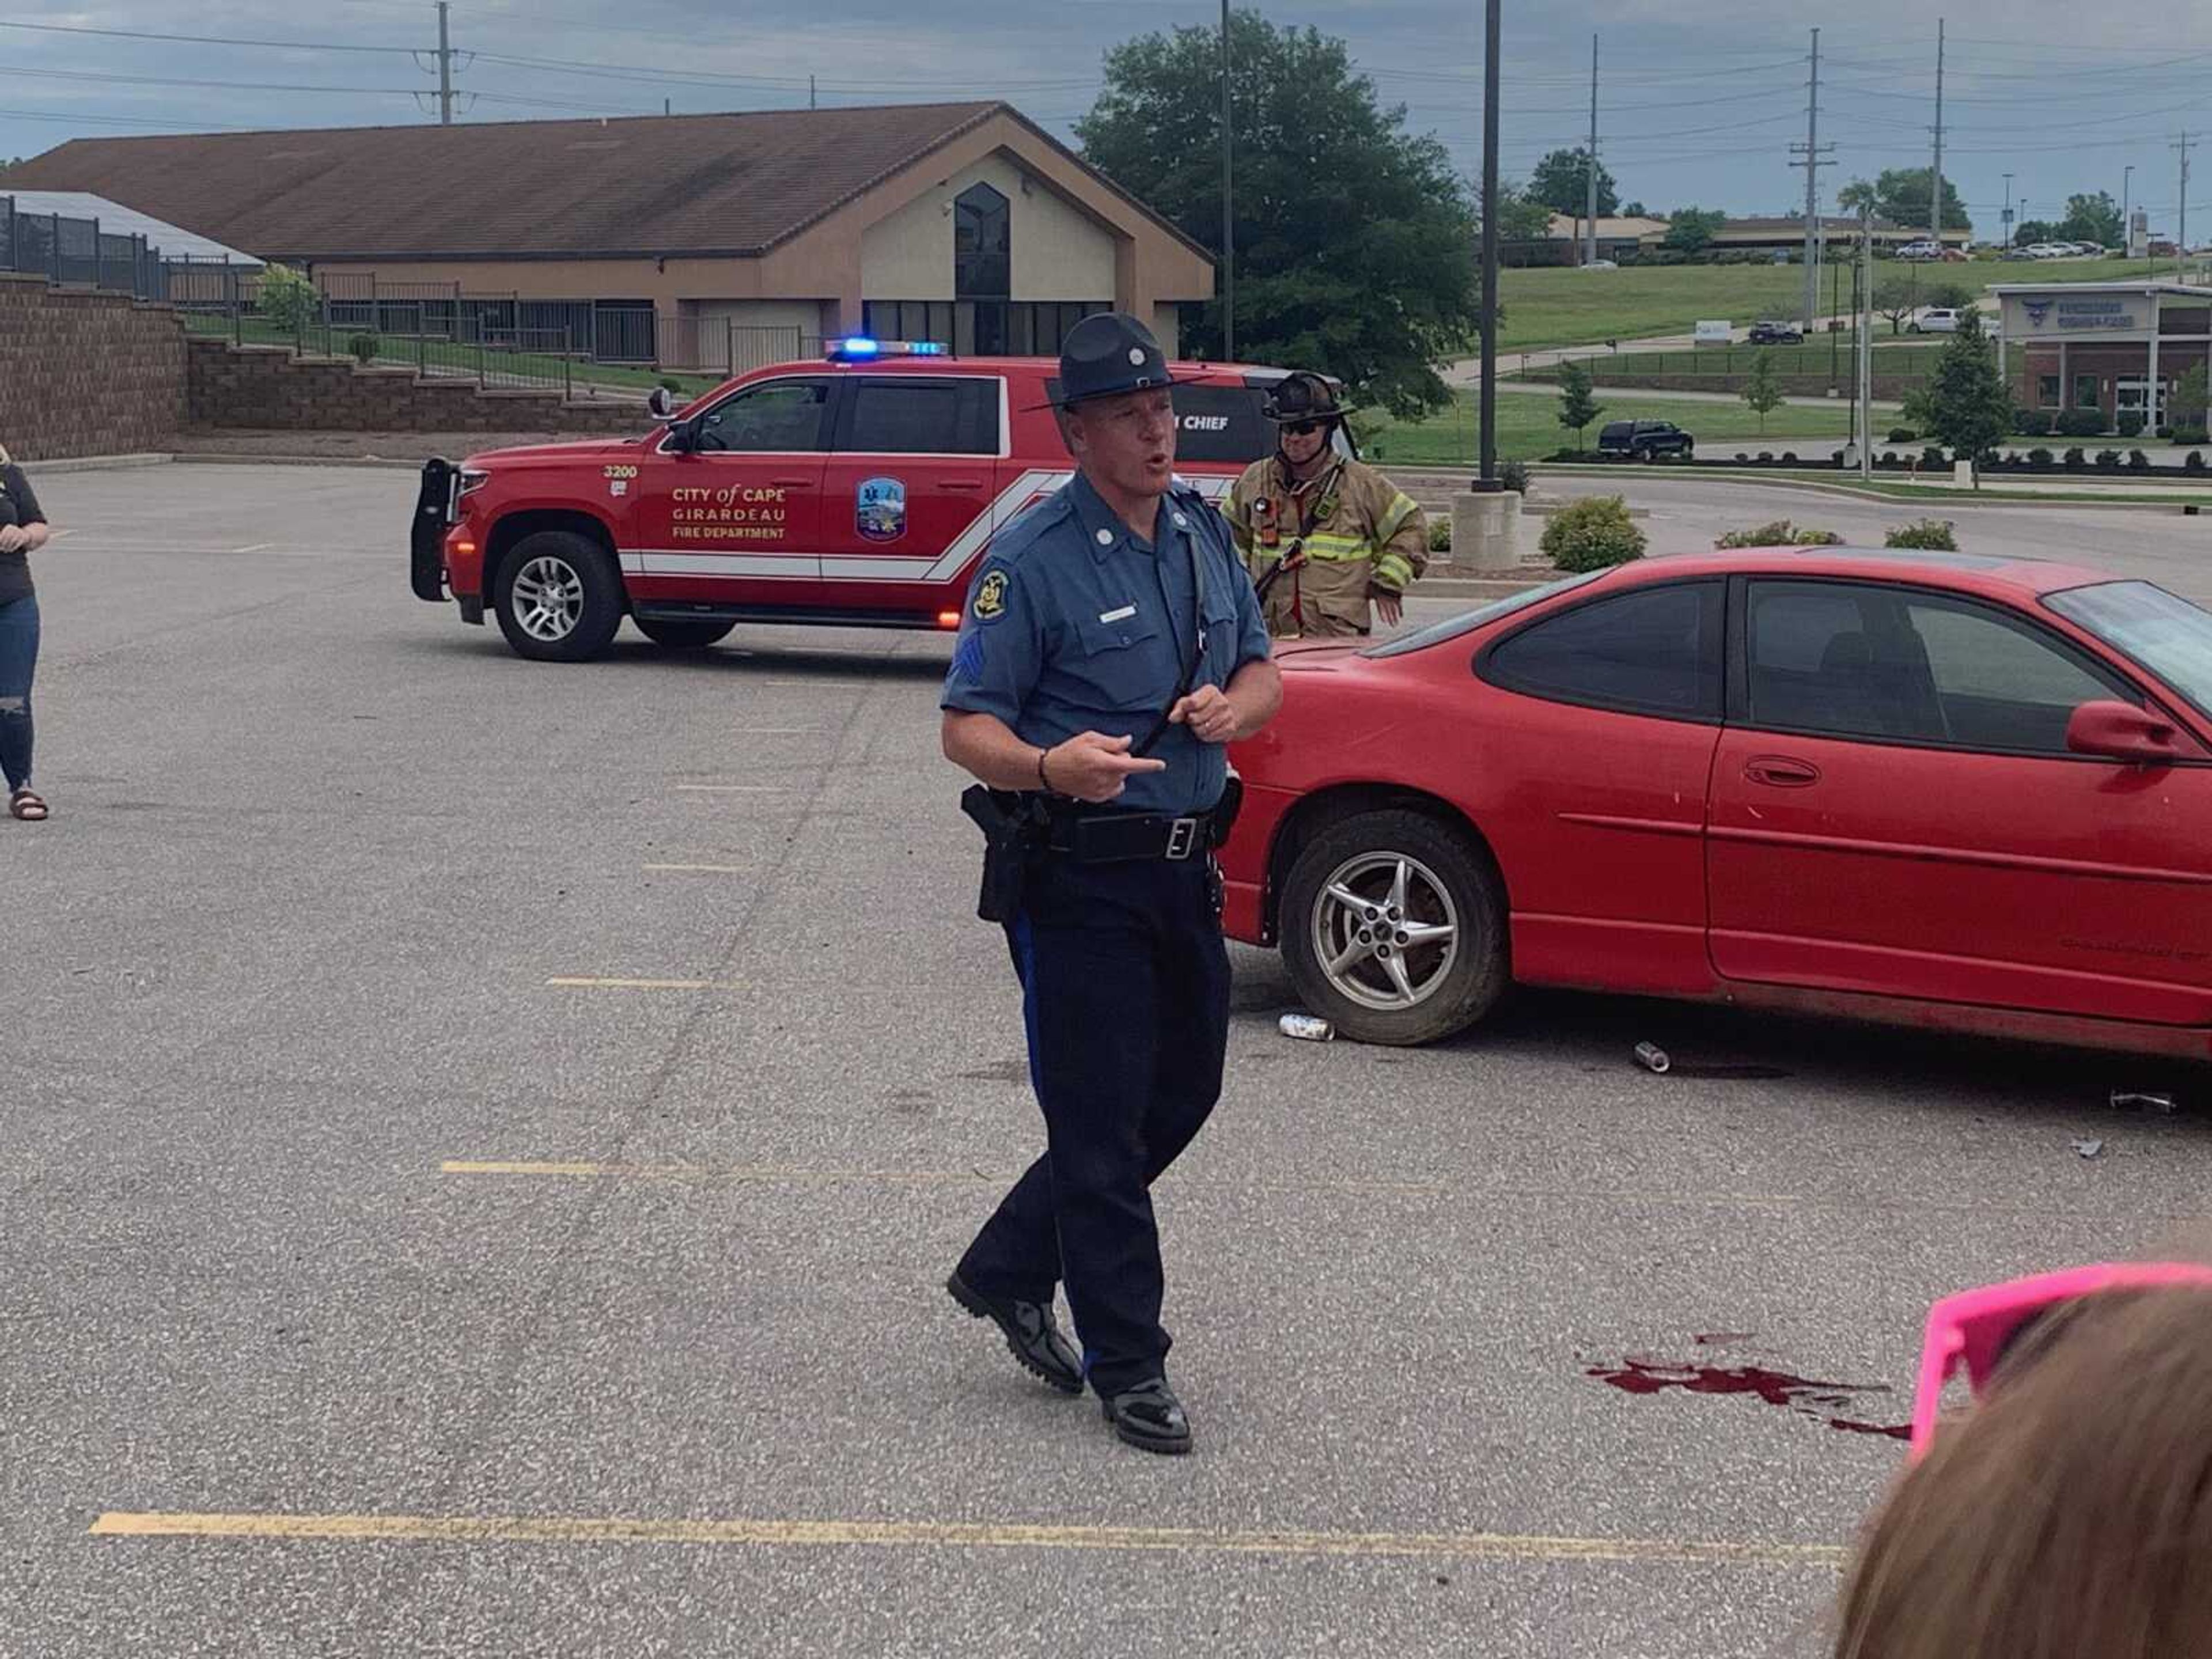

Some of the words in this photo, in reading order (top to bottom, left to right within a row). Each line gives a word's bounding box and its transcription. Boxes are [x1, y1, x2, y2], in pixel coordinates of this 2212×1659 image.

[1184, 416, 1229, 430] CHIEF
[604, 465, 638, 478] 3200
[672, 488, 711, 502] CITY
[716, 484, 742, 507] of
[743, 488, 786, 502] CAPE
[672, 509, 785, 521] GIRARDEAU
[672, 527, 701, 539] FIRE
[703, 527, 786, 540] DEPARTMENT
